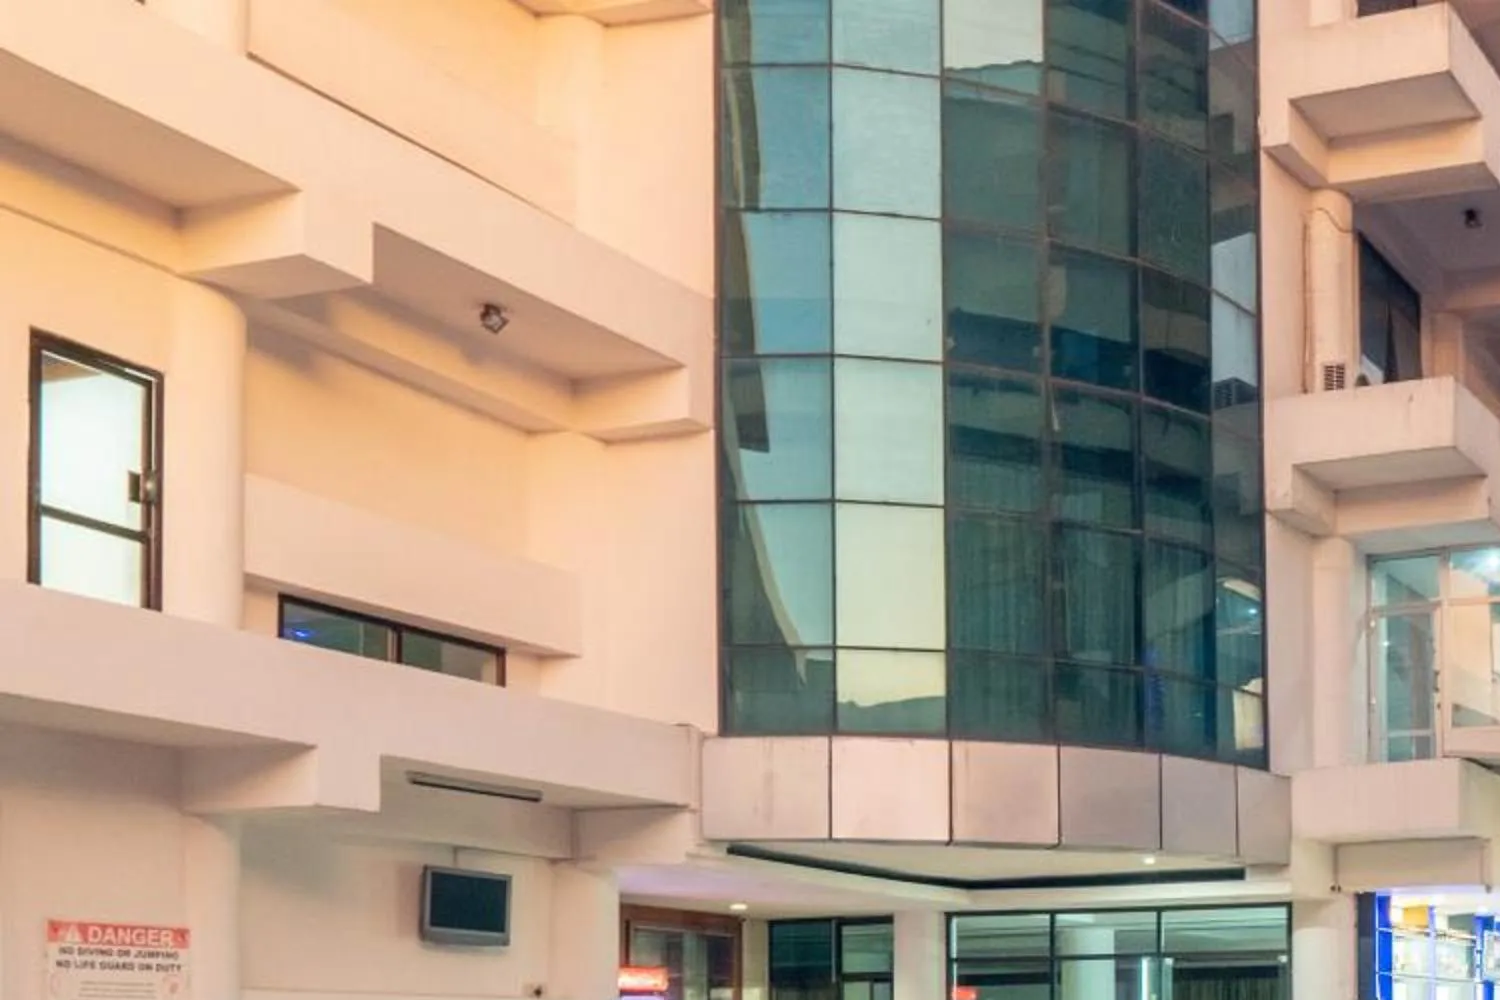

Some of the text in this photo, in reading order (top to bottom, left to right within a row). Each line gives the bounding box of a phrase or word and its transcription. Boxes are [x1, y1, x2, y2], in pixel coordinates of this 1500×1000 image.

[88, 925, 174, 947] DANGER
[56, 960, 182, 972] NO LIFE GUARD ON DUTY
